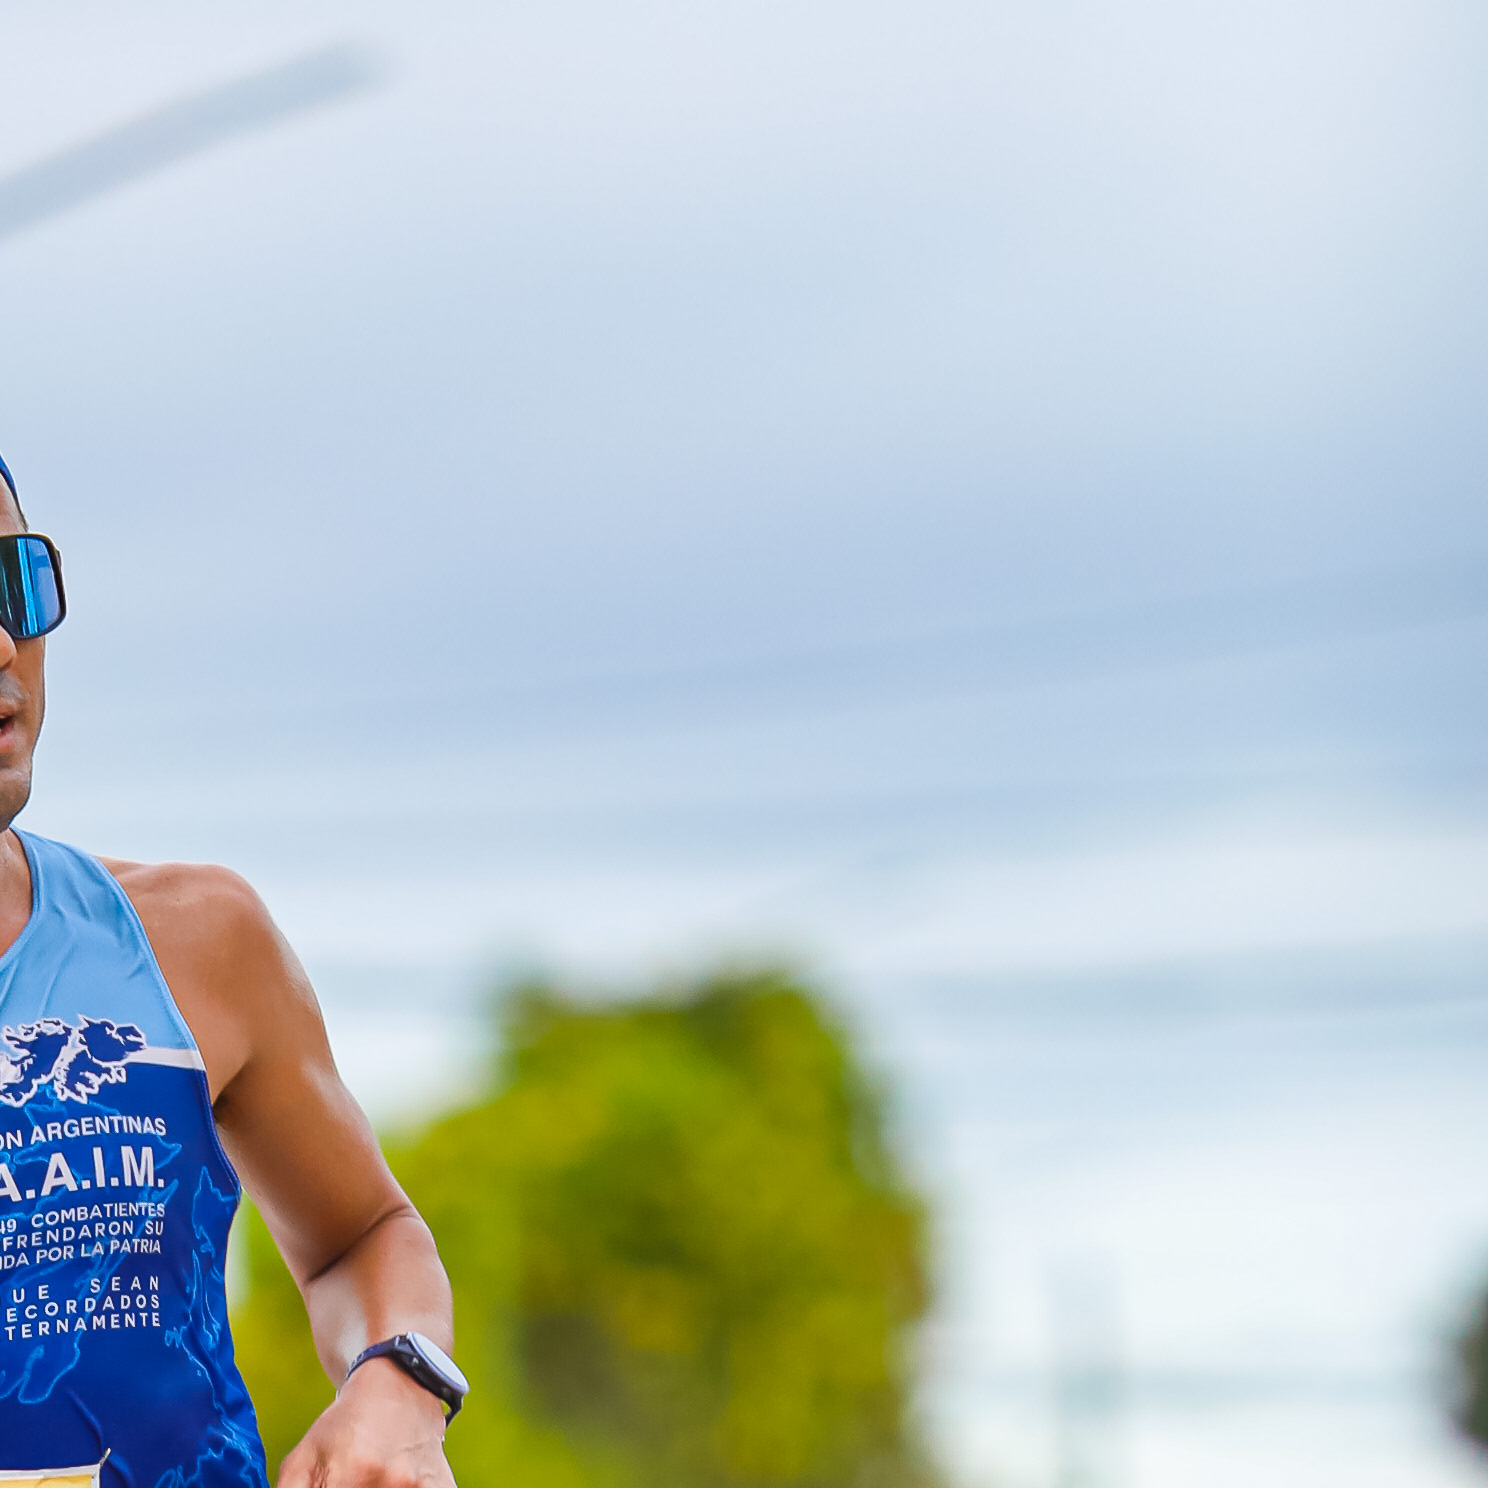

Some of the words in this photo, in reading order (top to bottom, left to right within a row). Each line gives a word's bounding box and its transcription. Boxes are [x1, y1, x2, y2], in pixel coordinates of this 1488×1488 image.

[30, 1115, 167, 1145] ARGENTINAS
[31, 1202, 166, 1228] COMBATIENTES
[145, 1220, 164, 1236] SU
[36, 1245, 75, 1264] POR
[80, 1241, 105, 1258] LA
[110, 1238, 162, 1255] PATRIA
[90, 1275, 159, 1294] SEAN
